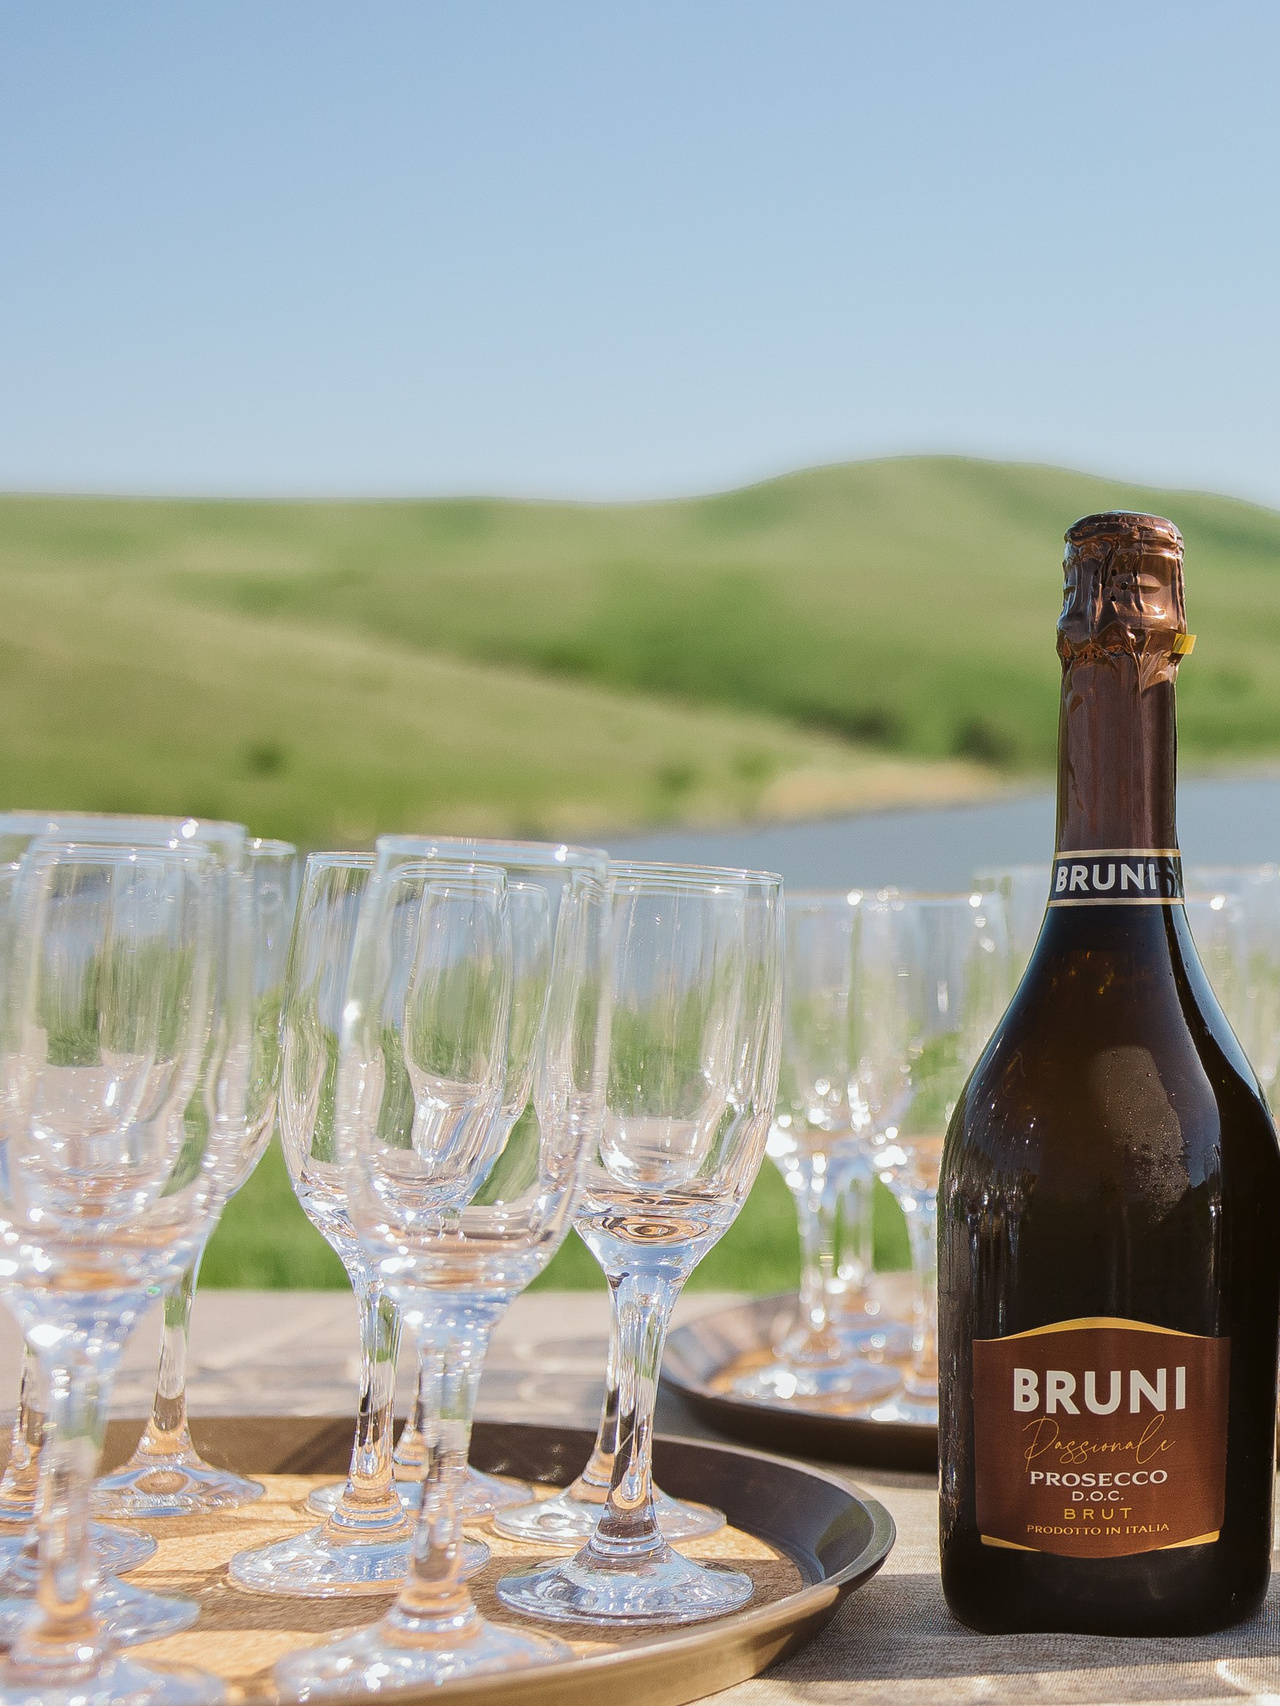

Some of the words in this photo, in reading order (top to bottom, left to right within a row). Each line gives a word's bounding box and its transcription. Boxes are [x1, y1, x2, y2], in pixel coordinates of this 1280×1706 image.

[1055, 864, 1157, 892] BRUNI
[1013, 1366, 1186, 1415] BRUNI
[1021, 1413, 1176, 1473] Passionale
[1029, 1469, 1168, 1487] PROSECCO
[1071, 1490, 1124, 1502] D.O.C.
[1063, 1507, 1132, 1520] BRUT
[1026, 1524, 1101, 1536] PRODOTTO
[1106, 1526, 1121, 1535] IN
[1125, 1523, 1170, 1534] ITALIA
